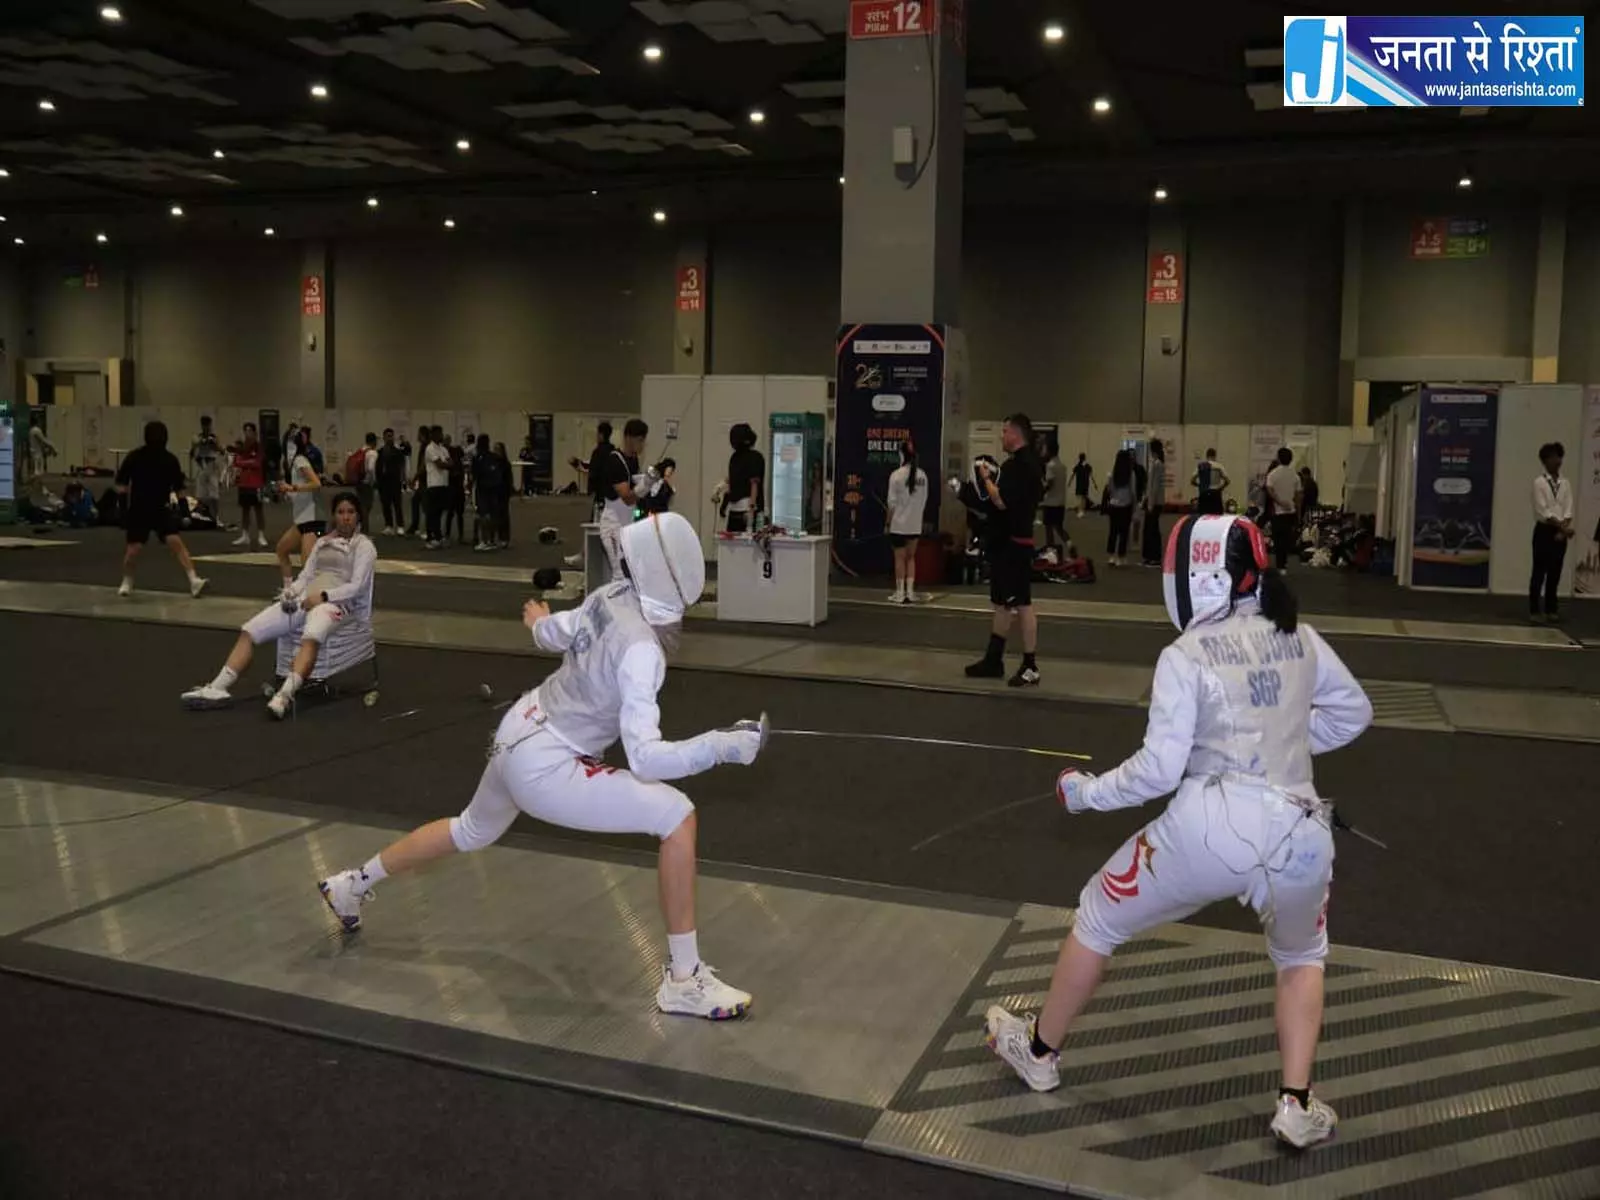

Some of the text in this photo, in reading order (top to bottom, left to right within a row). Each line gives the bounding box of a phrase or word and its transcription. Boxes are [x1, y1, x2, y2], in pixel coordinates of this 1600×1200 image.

[893, 1, 920, 31] 12
[1162, 254, 1176, 278] 3
[310, 277, 320, 296] 3
[687, 268, 698, 290] 3
[1191, 541, 1220, 564] SGP
[763, 561, 772, 578] 9
[1247, 669, 1281, 707] SGP
